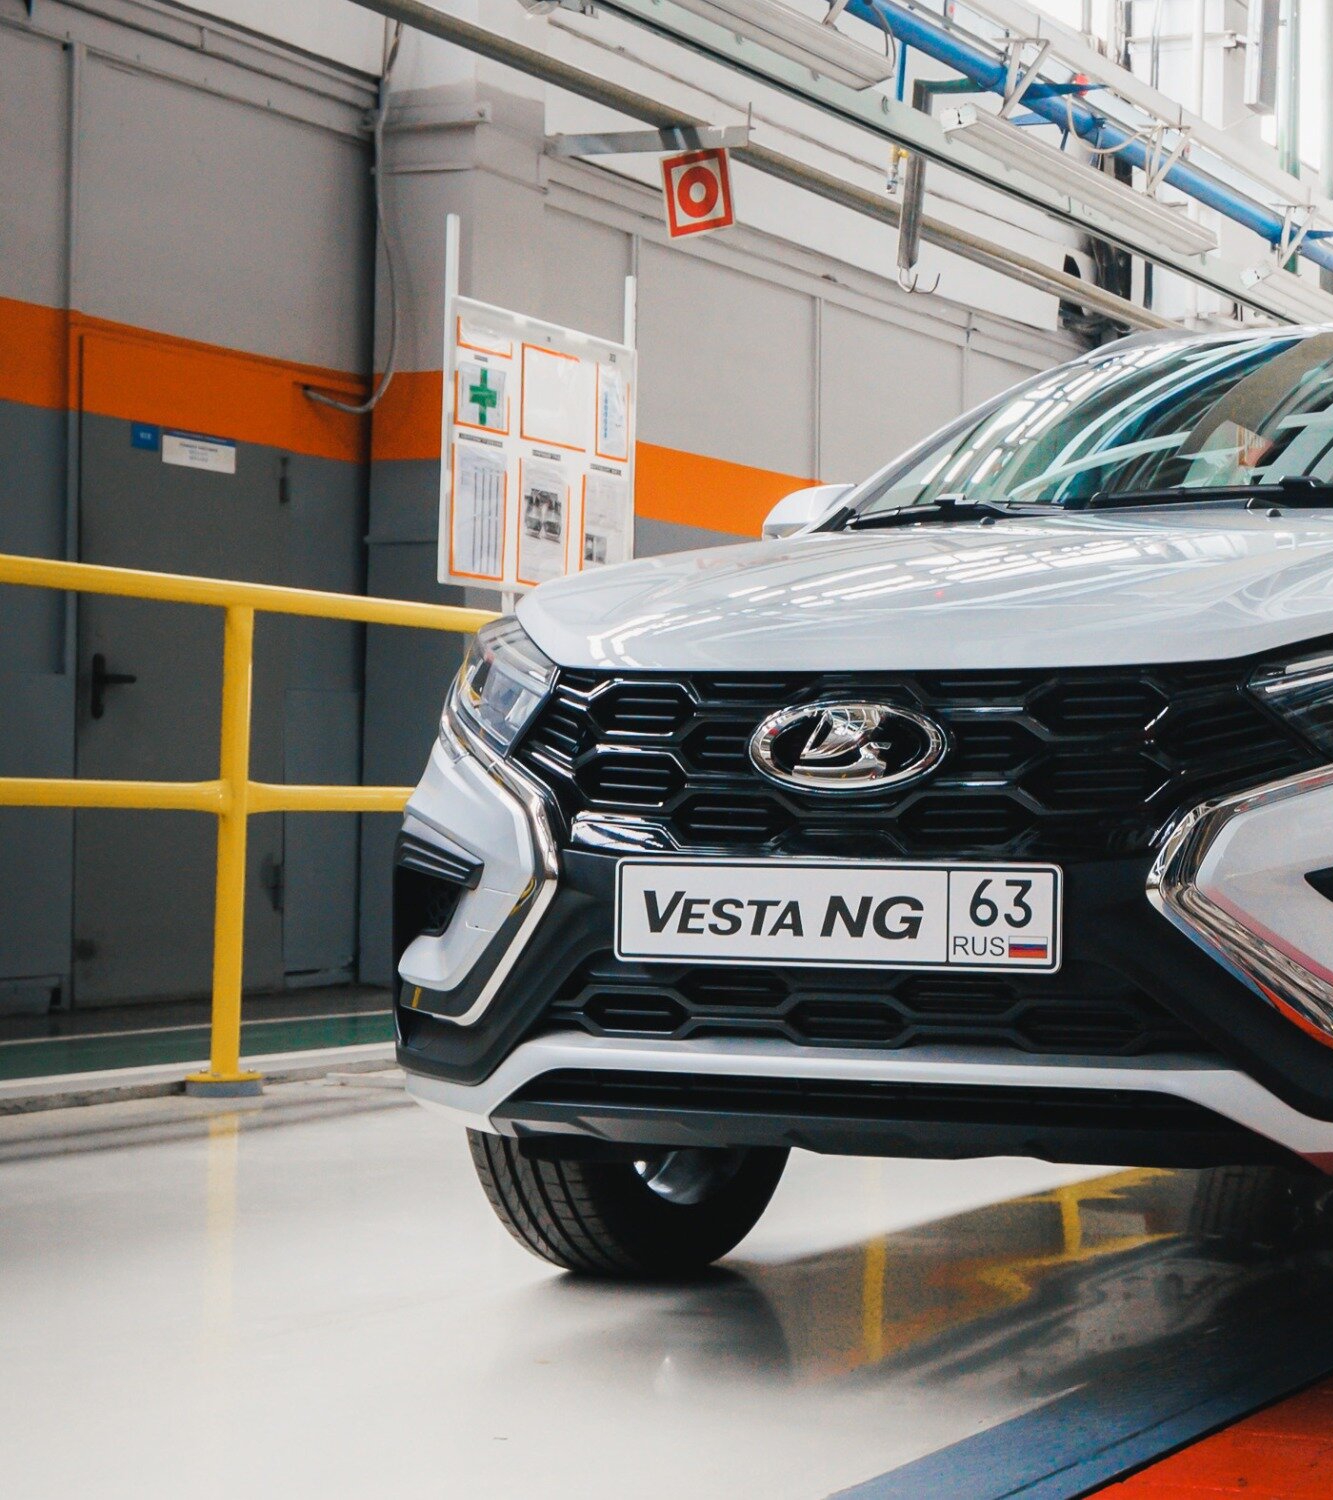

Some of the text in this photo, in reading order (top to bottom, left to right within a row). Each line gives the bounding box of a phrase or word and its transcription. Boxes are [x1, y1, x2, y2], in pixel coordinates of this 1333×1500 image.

[643, 890, 924, 940] VESTA NG
[969, 878, 1033, 929] 63
[953, 935, 1005, 957] RUS
